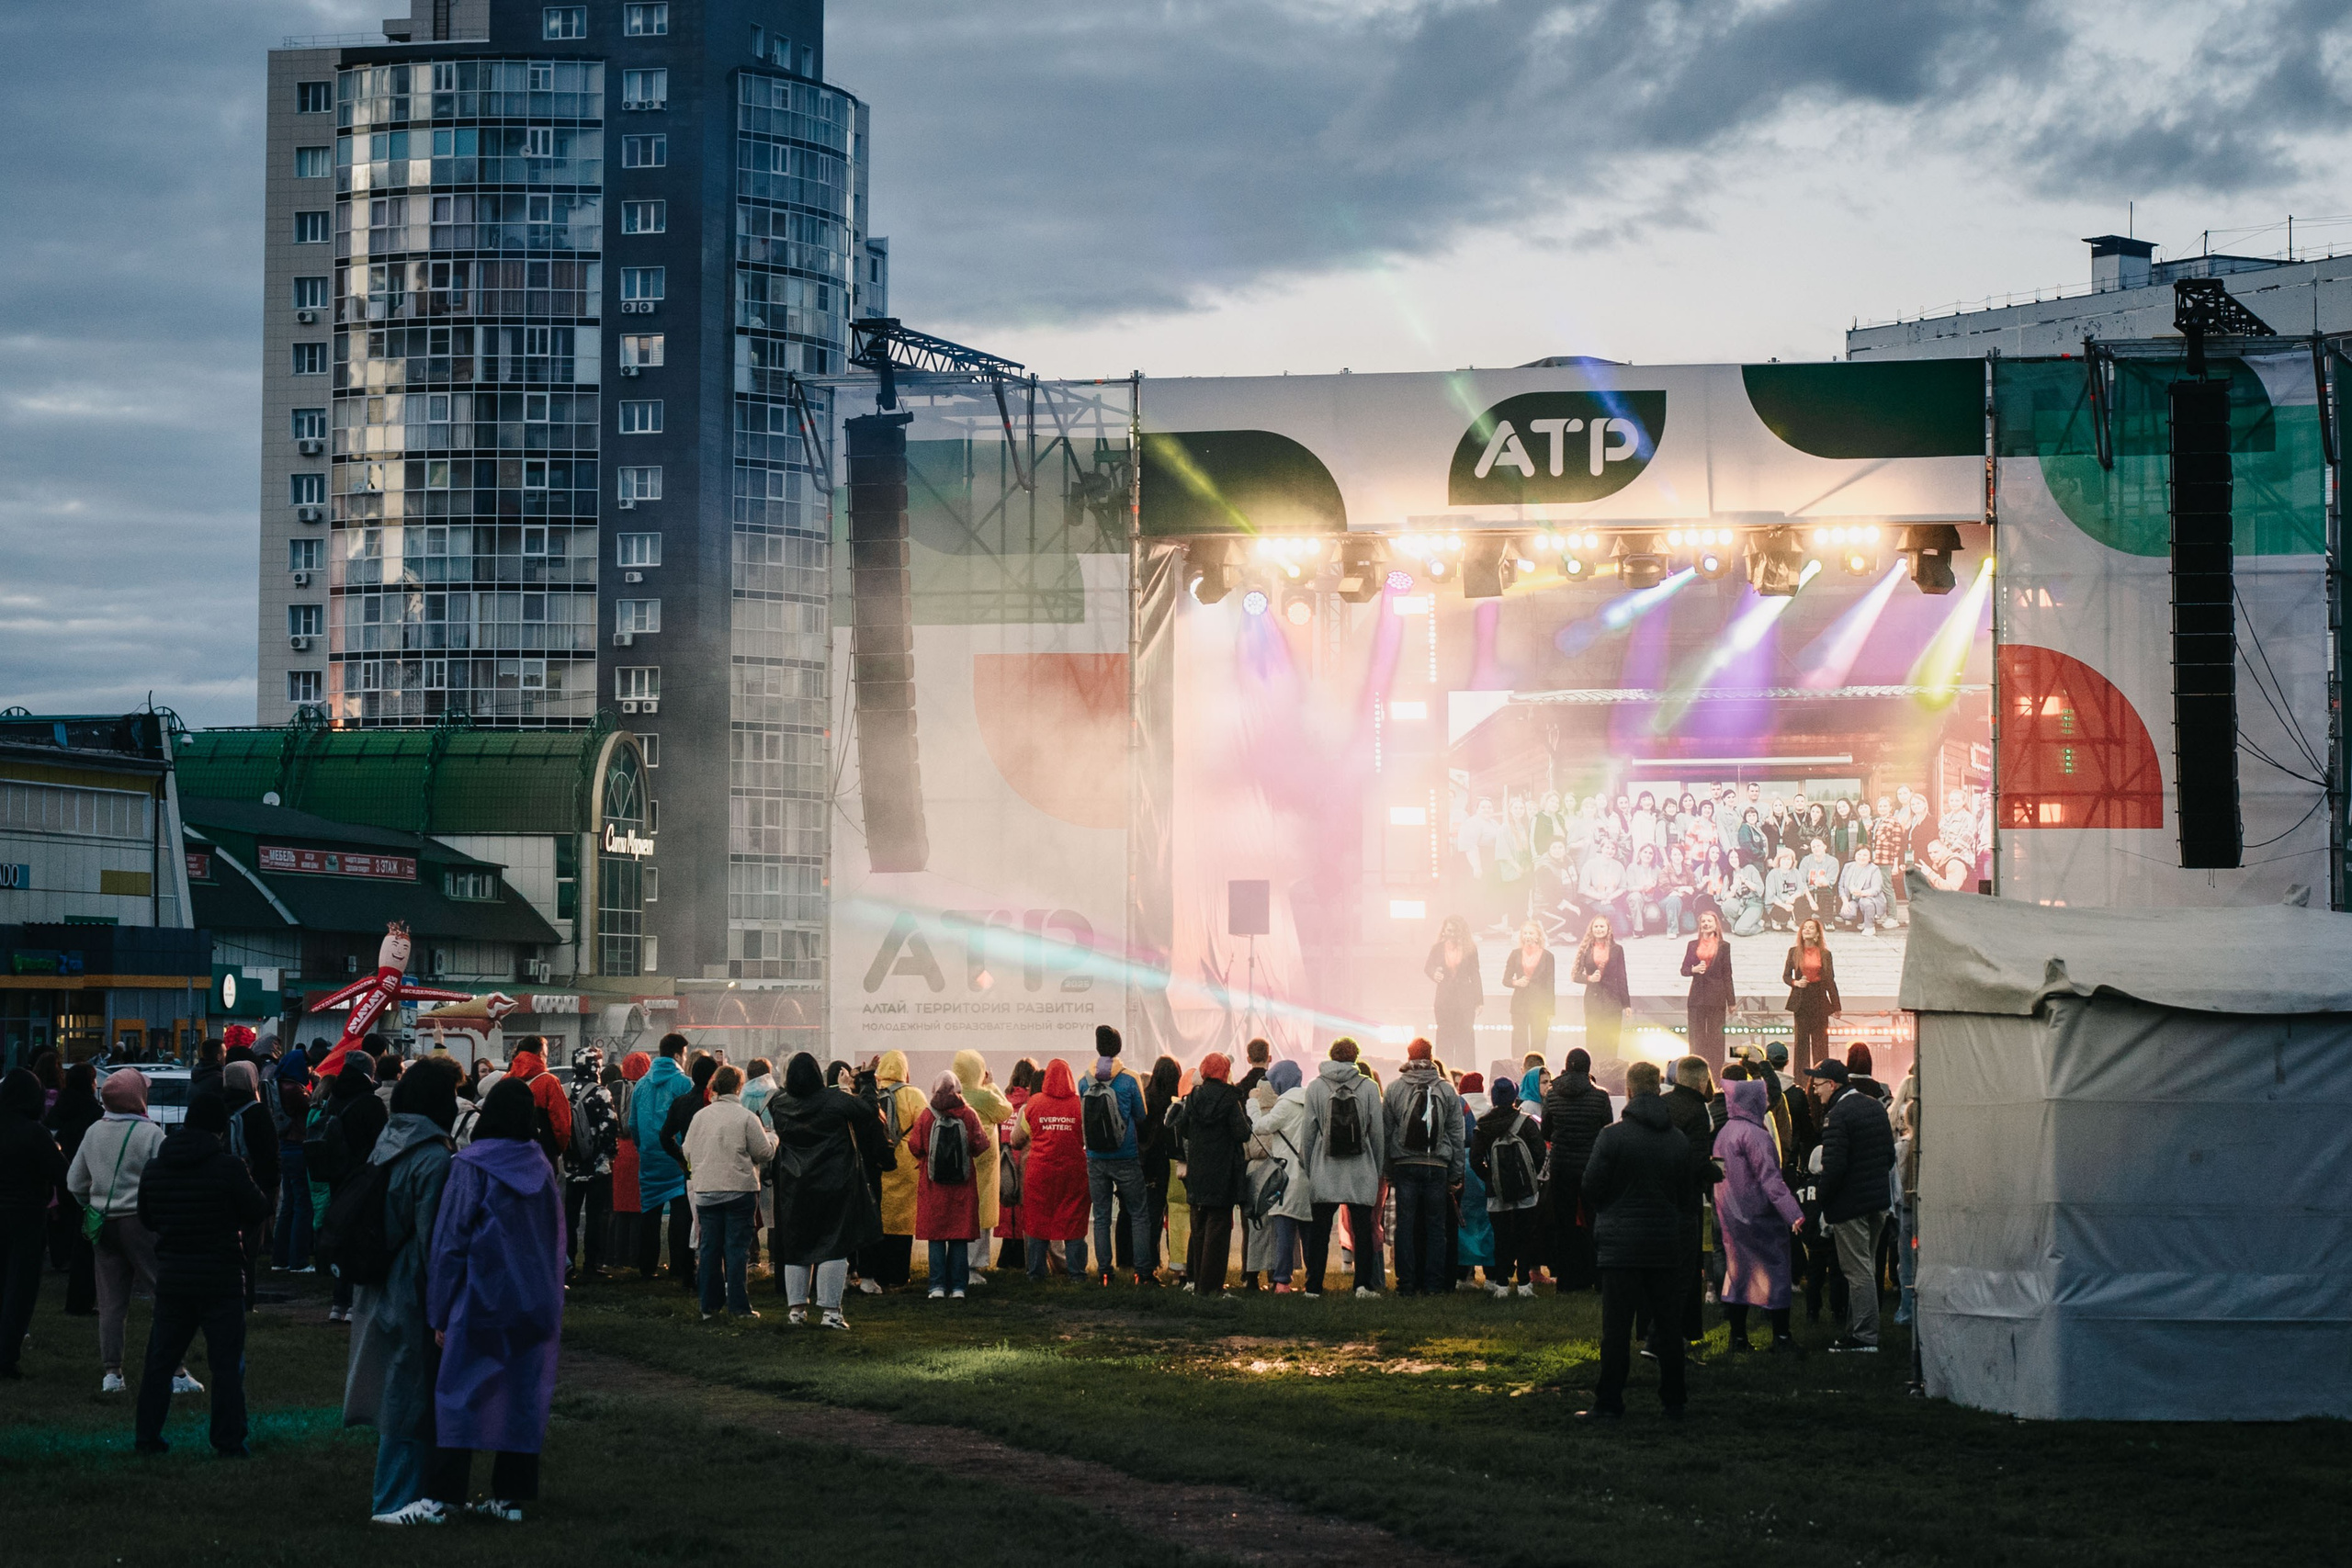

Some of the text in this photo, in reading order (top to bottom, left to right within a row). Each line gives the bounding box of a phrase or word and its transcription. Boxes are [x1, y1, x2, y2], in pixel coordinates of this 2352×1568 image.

[1474, 417, 1640, 479] АТР
[269, 849, 296, 863] МЕБЕЛЬ
[375, 859, 379, 874] 3
[380, 860, 399, 874] ЭТАЖ
[1064, 980, 1091, 989] 2025
[915, 1002, 1011, 1014] ТЕРРИТОРИЯ
[1016, 1002, 1094, 1014] РАЗВИТИЯ
[862, 1021, 1094, 1032] МОЛОДЕЖНЫЙ ОБРАЗОВАТЕЛЬНЫЙ ФОРУМ
[1039, 1116, 1076, 1124] EVERYONE
[1042, 1123, 1072, 1132] MATTERS
